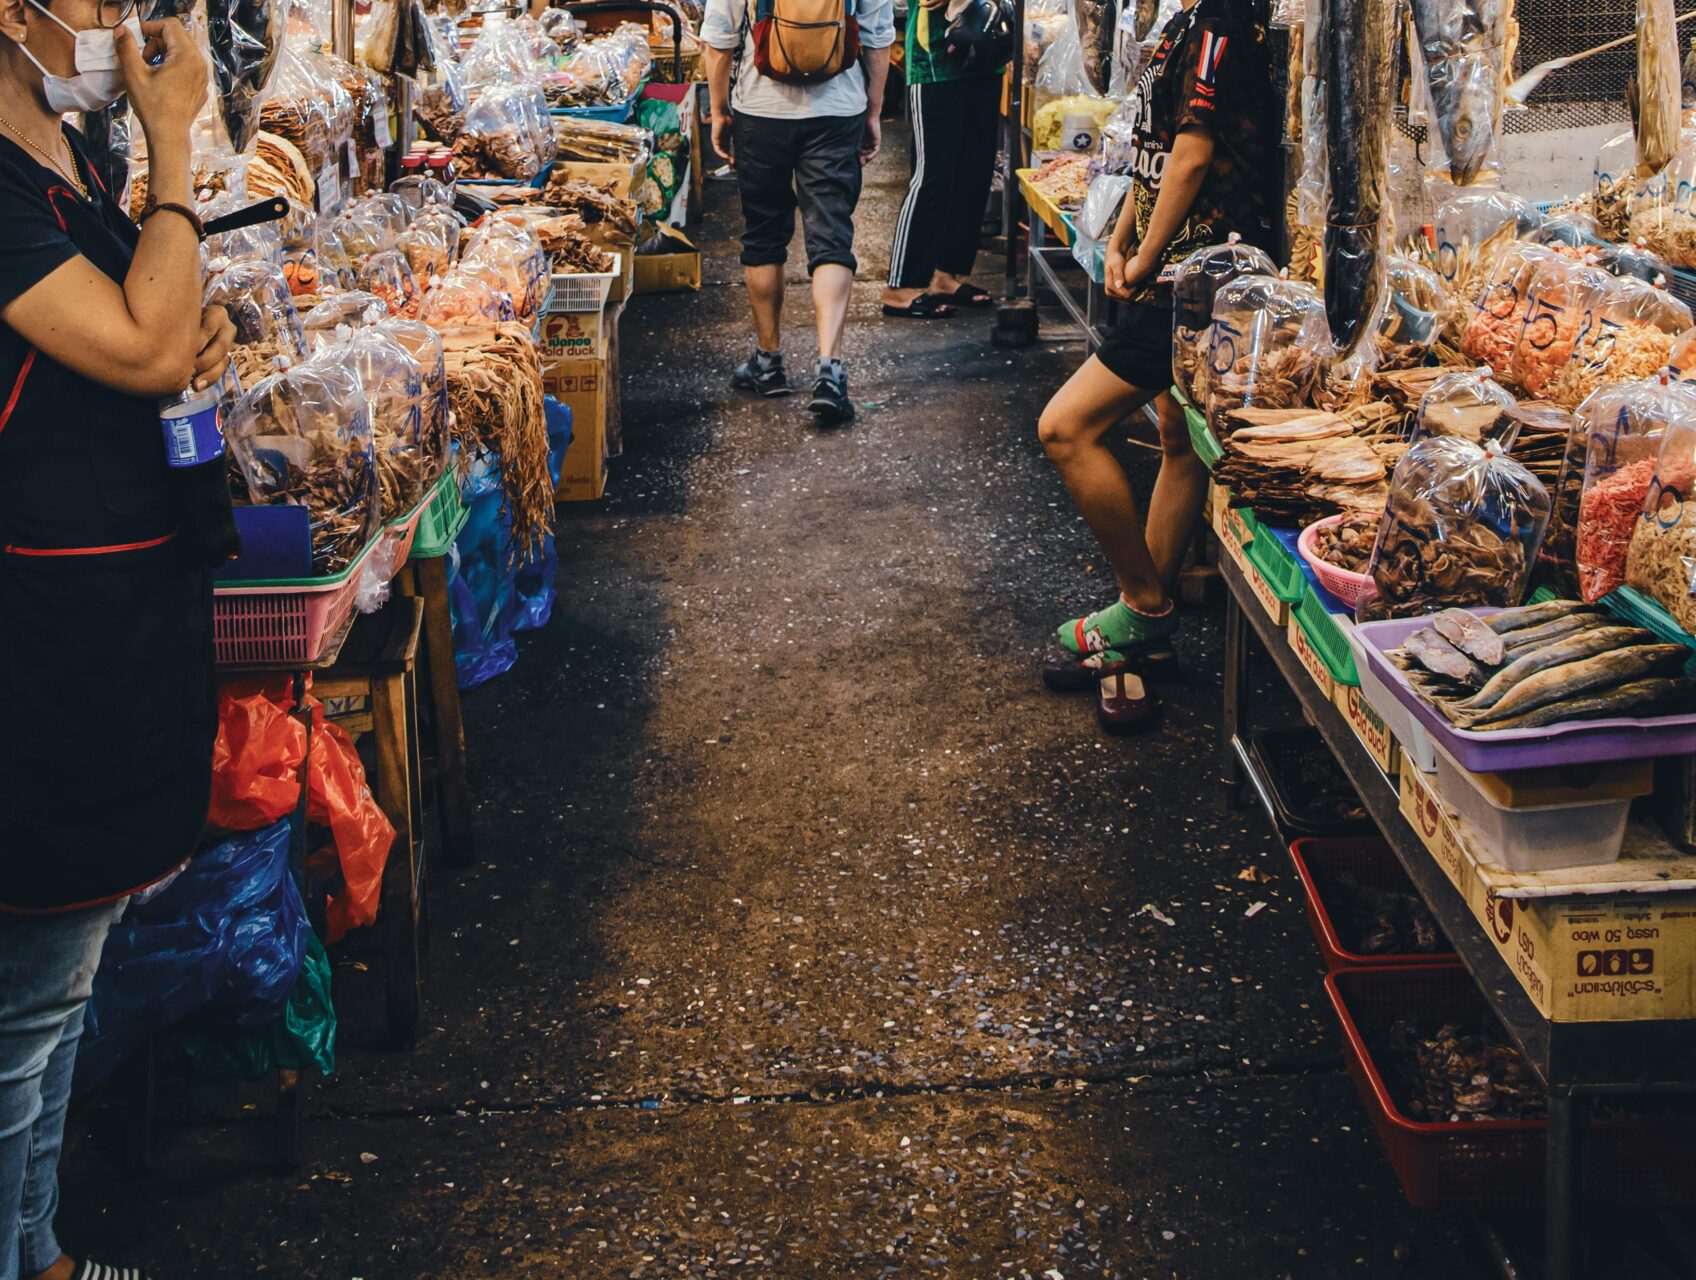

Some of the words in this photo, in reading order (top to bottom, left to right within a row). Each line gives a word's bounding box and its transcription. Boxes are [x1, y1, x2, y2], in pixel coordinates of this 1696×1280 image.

[567, 346, 595, 356] duck
[1571, 929, 1600, 943] ฟอง
[1605, 928, 1622, 942] 50
[1627, 926, 1660, 940] บรรจุ
